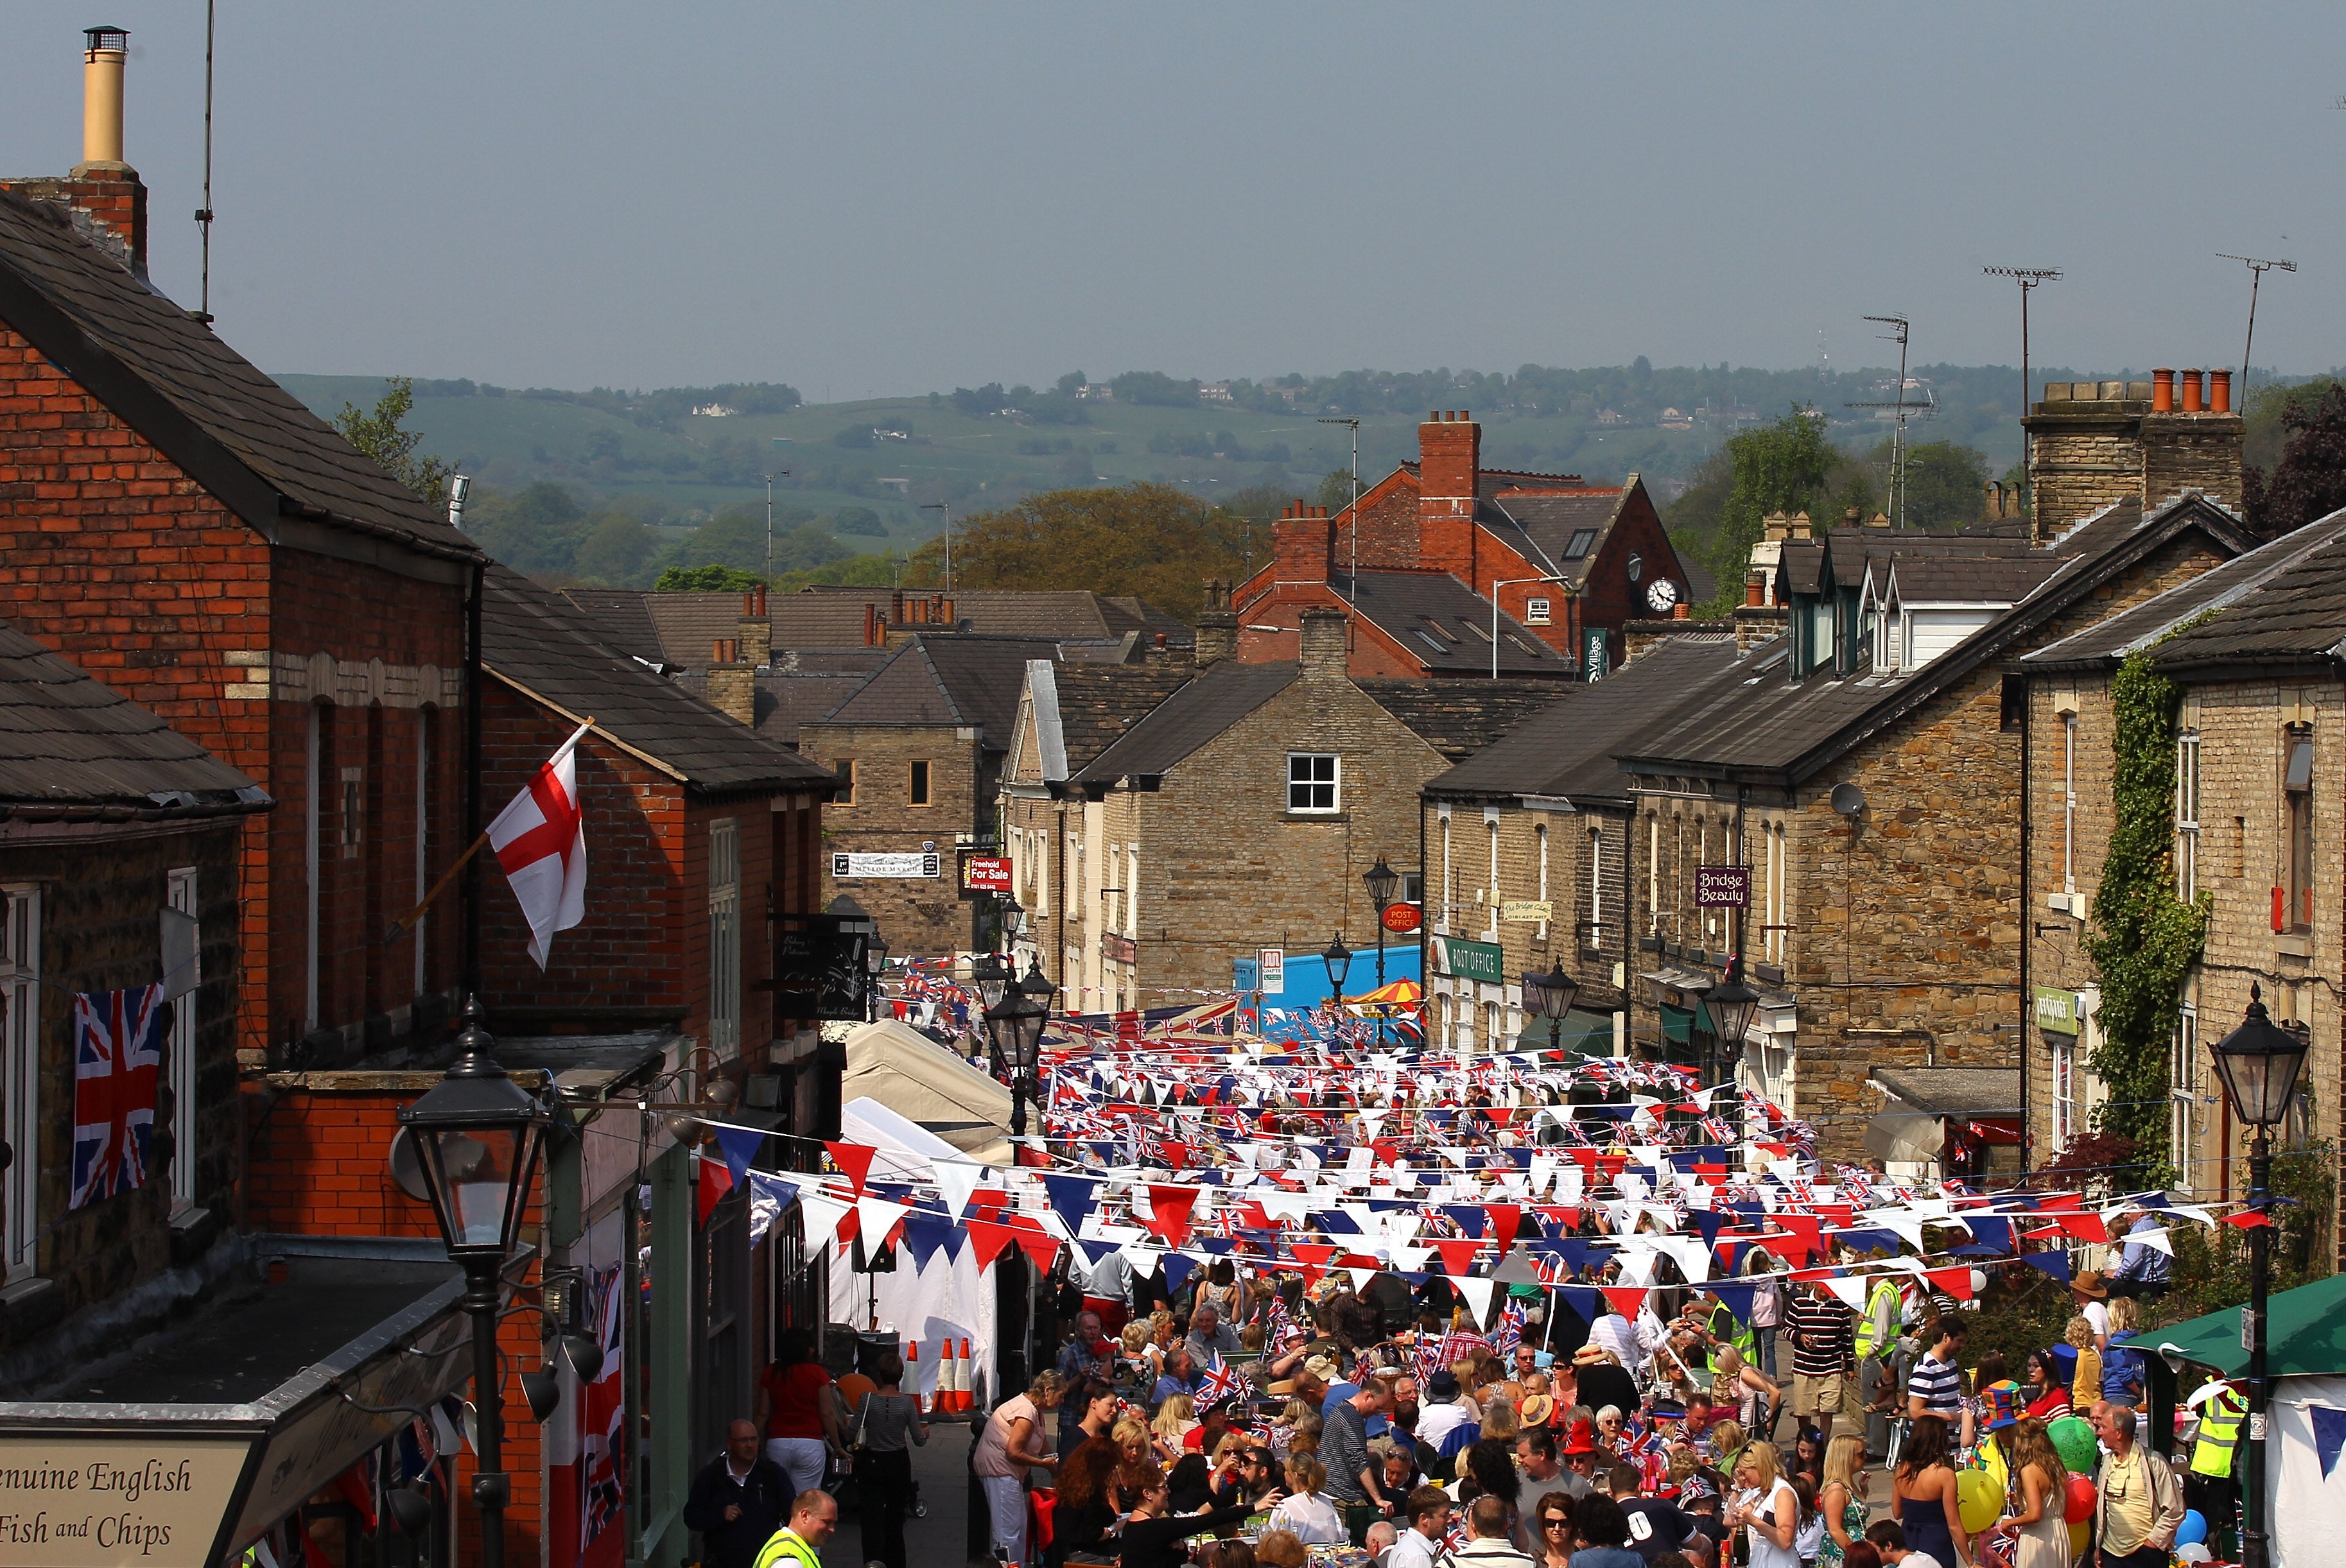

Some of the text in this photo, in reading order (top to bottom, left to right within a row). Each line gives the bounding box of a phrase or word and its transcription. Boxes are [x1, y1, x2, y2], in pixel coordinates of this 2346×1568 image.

[1588, 636, 1602, 672] Village
[971, 868, 1009, 879] For Sale
[1699, 873, 1743, 890] Bridge
[1699, 888, 1744, 904] Beauty
[1453, 948, 1468, 969] POST
[1470, 952, 1494, 974] OFFICE
[87, 1459, 192, 1502] English
[0, 1512, 172, 1555] Fish and Chips
